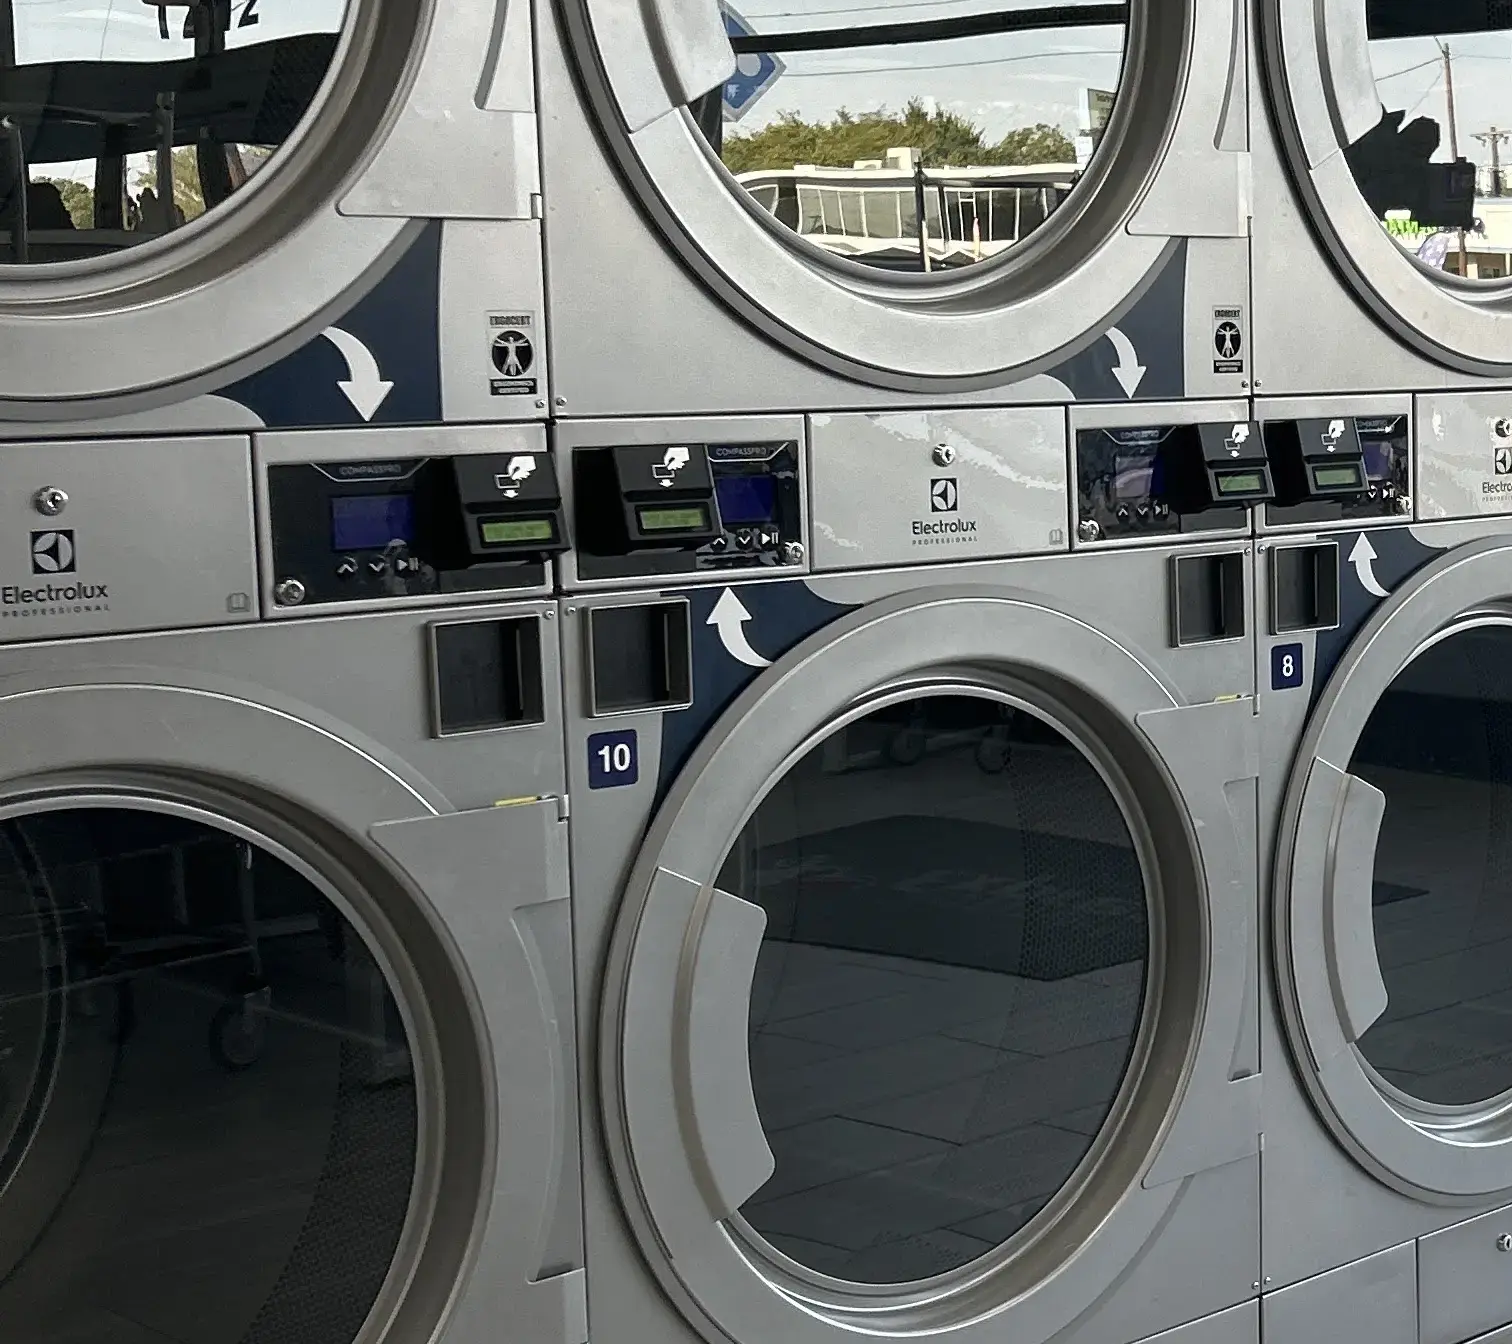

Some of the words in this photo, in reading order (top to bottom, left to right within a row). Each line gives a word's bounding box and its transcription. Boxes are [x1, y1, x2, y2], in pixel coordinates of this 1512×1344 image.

[911, 518, 977, 535] Electrolux
[911, 536, 978, 545] PROFESSIONAL
[2, 582, 109, 604] Electrolux
[2, 604, 110, 617] PROFESSIONAL
[1282, 654, 1294, 677] 8
[597, 743, 631, 773] 10
